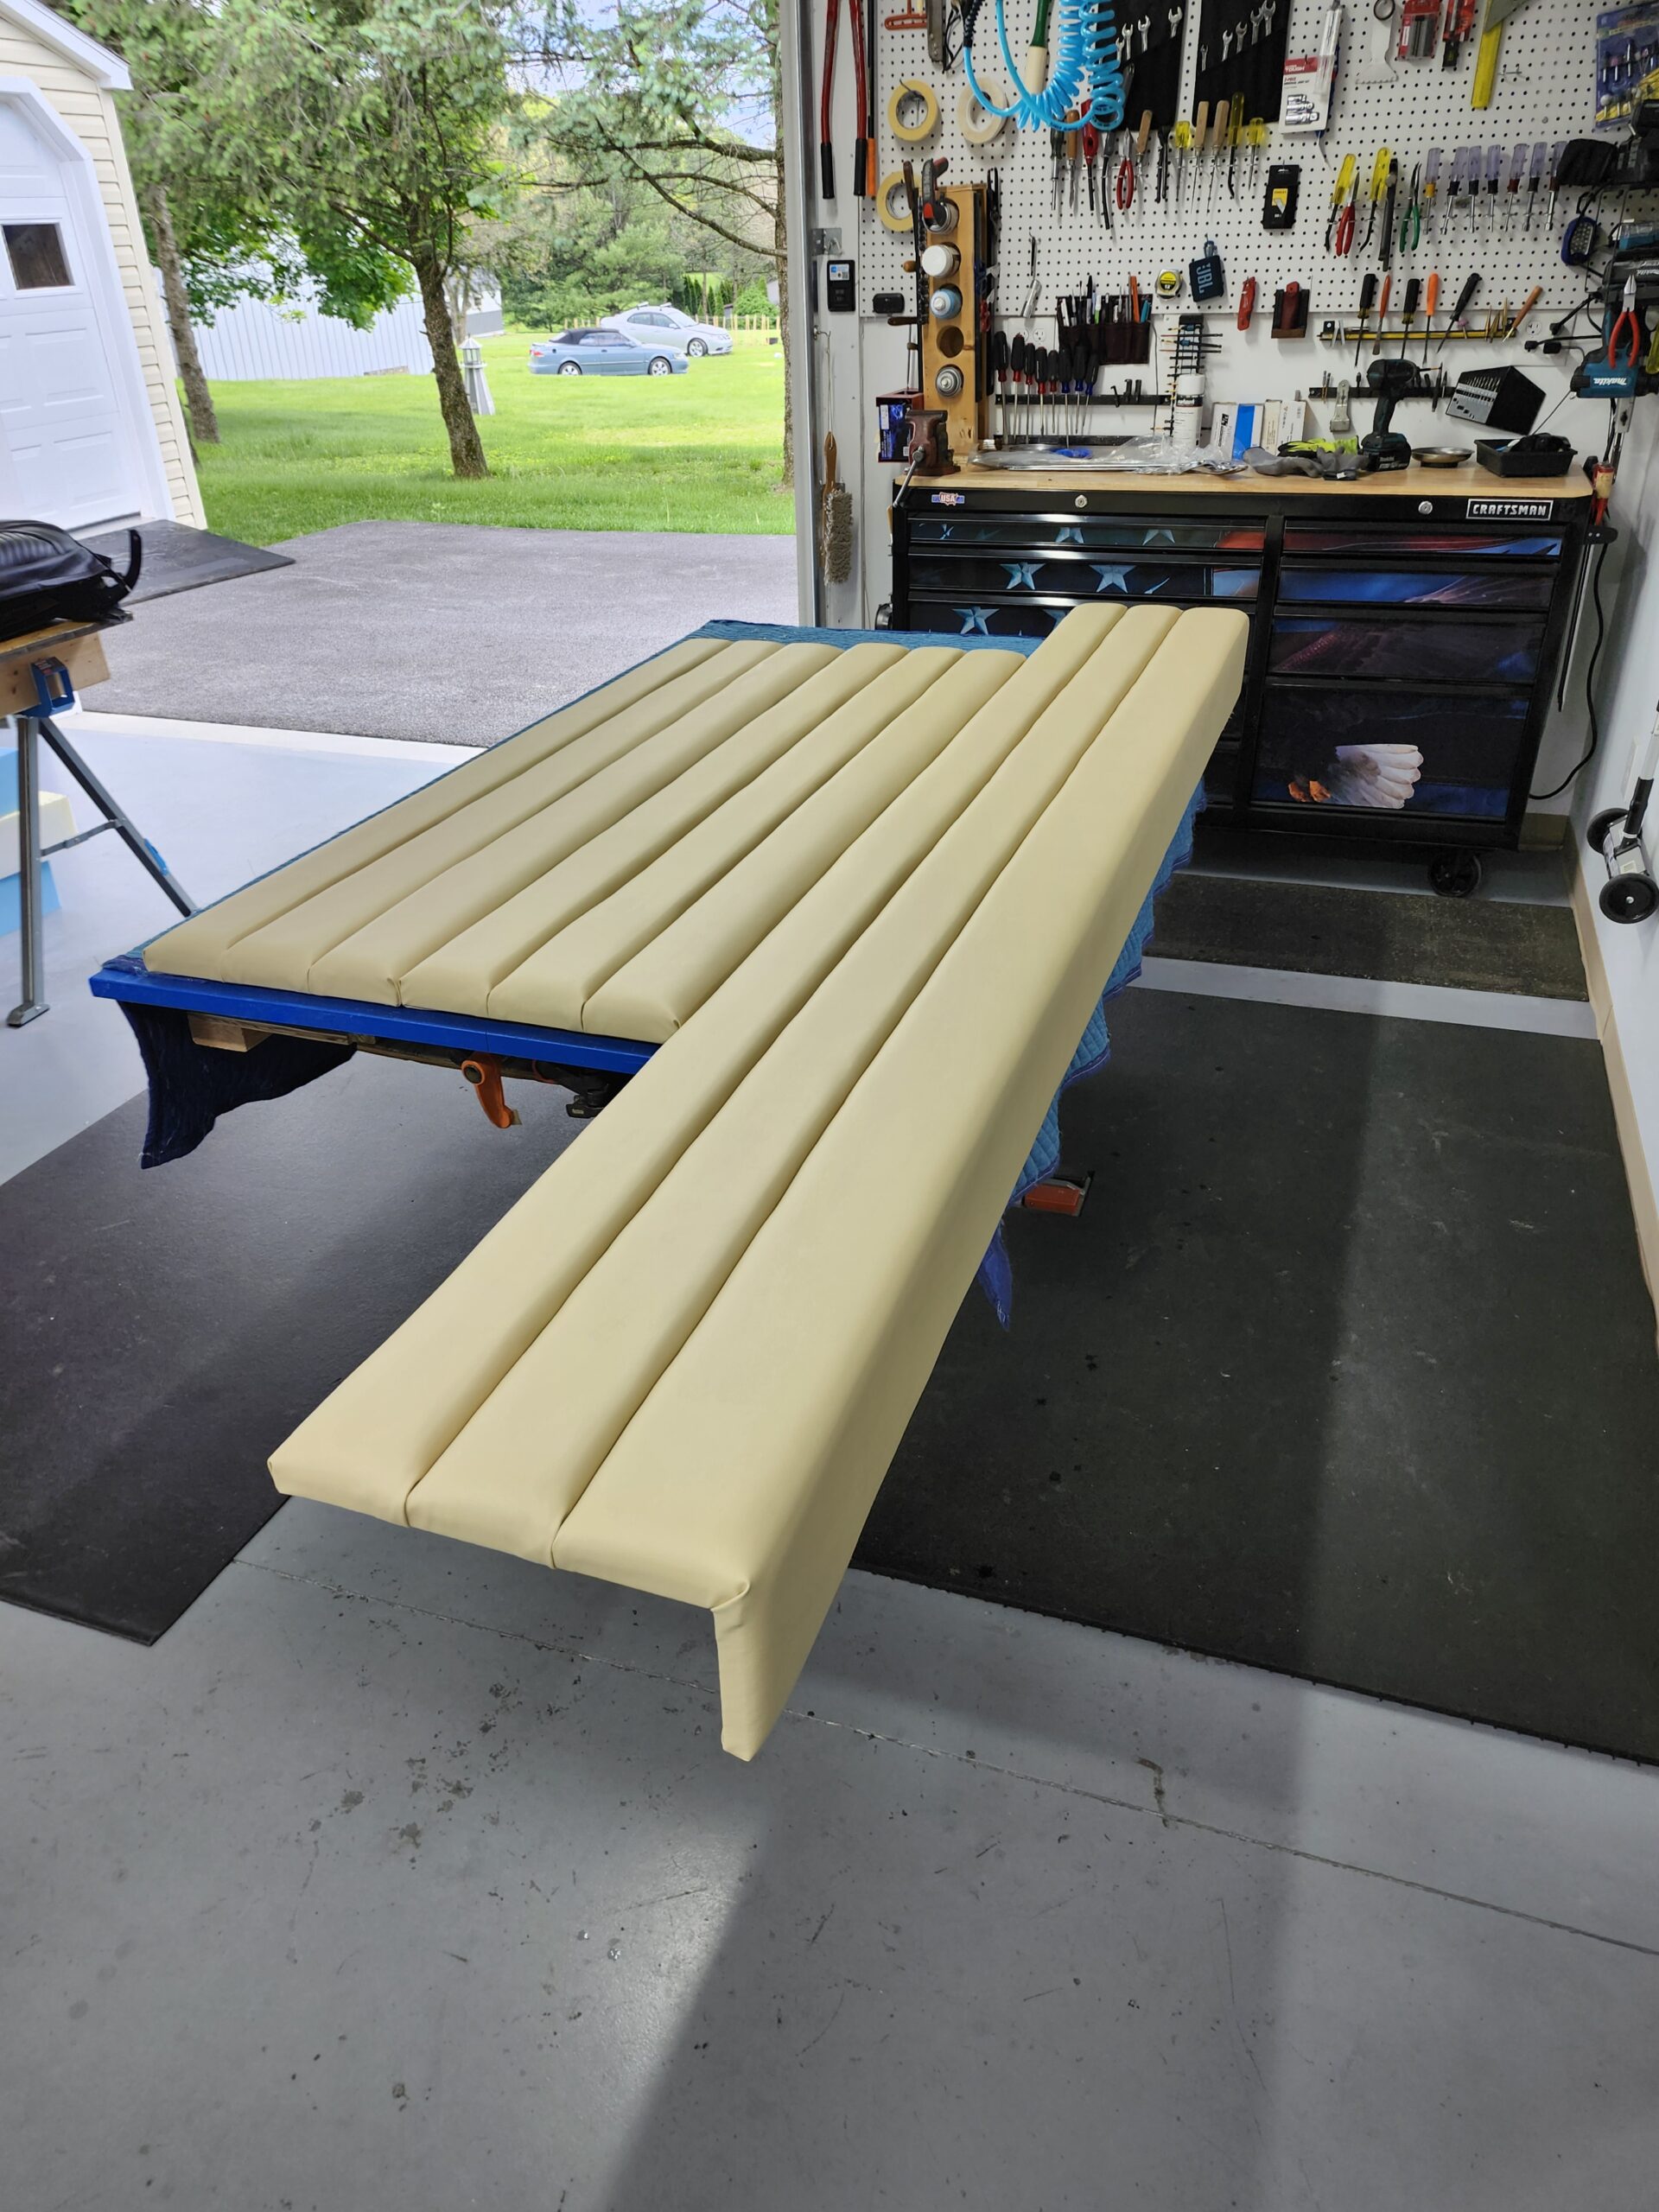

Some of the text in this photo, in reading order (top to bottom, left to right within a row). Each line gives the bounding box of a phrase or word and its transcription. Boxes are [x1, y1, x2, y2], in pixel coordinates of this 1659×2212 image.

[1196, 266, 1213, 294] JBL
[941, 493, 956, 502] USA
[1472, 504, 1547, 516] CRAFTSMAN
